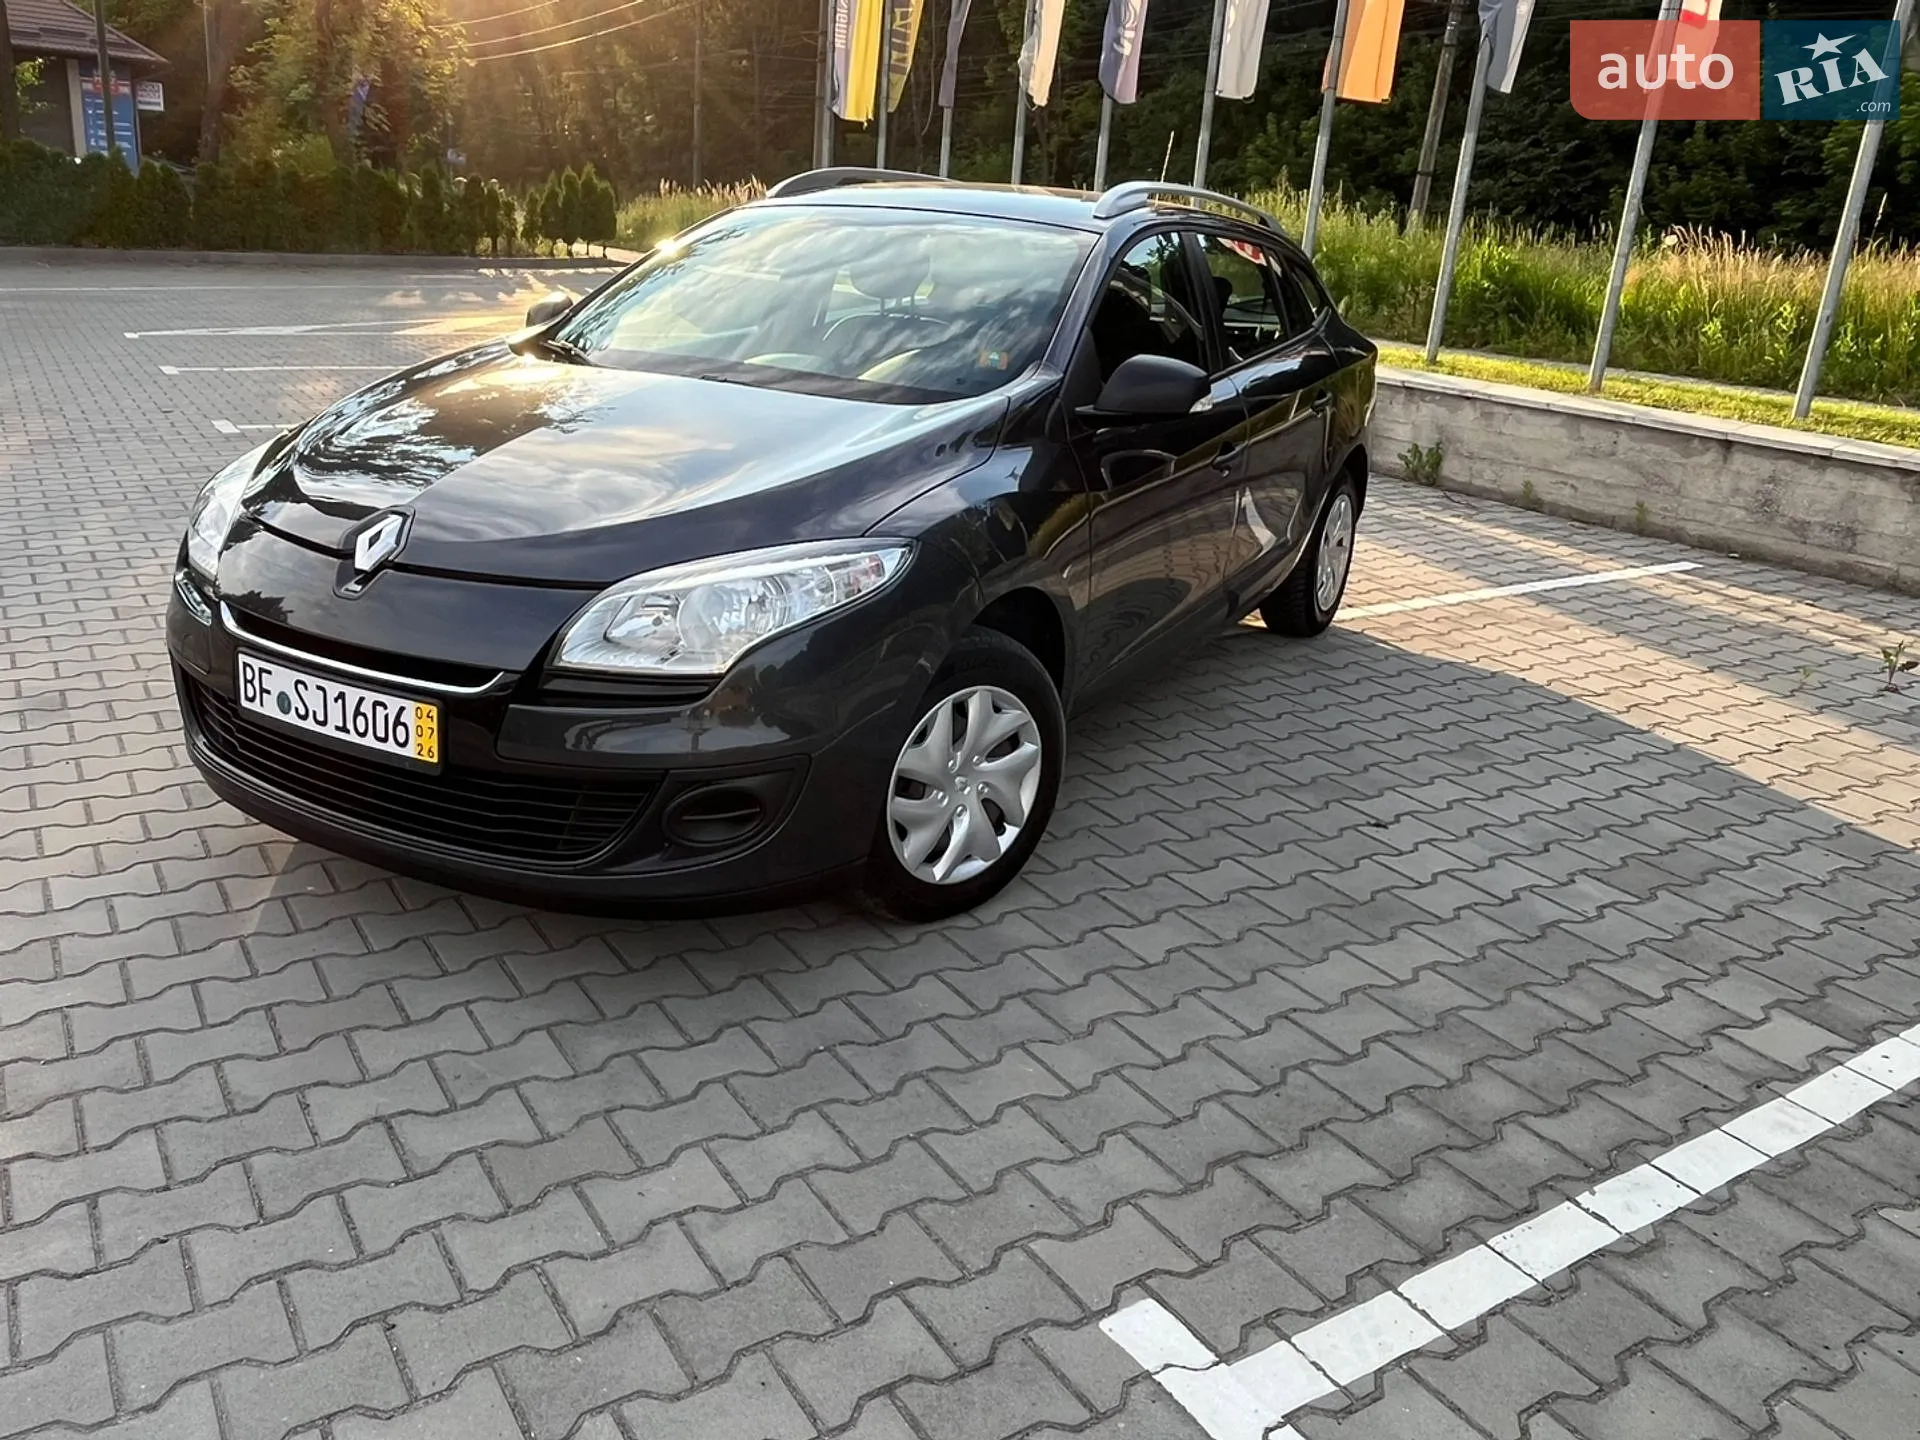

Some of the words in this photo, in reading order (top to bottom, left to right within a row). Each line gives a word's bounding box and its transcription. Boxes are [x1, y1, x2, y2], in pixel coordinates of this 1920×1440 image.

[242, 661, 272, 708] BF
[415, 706, 434, 723] 04
[416, 724, 435, 740] 07
[417, 743, 435, 759] 26
